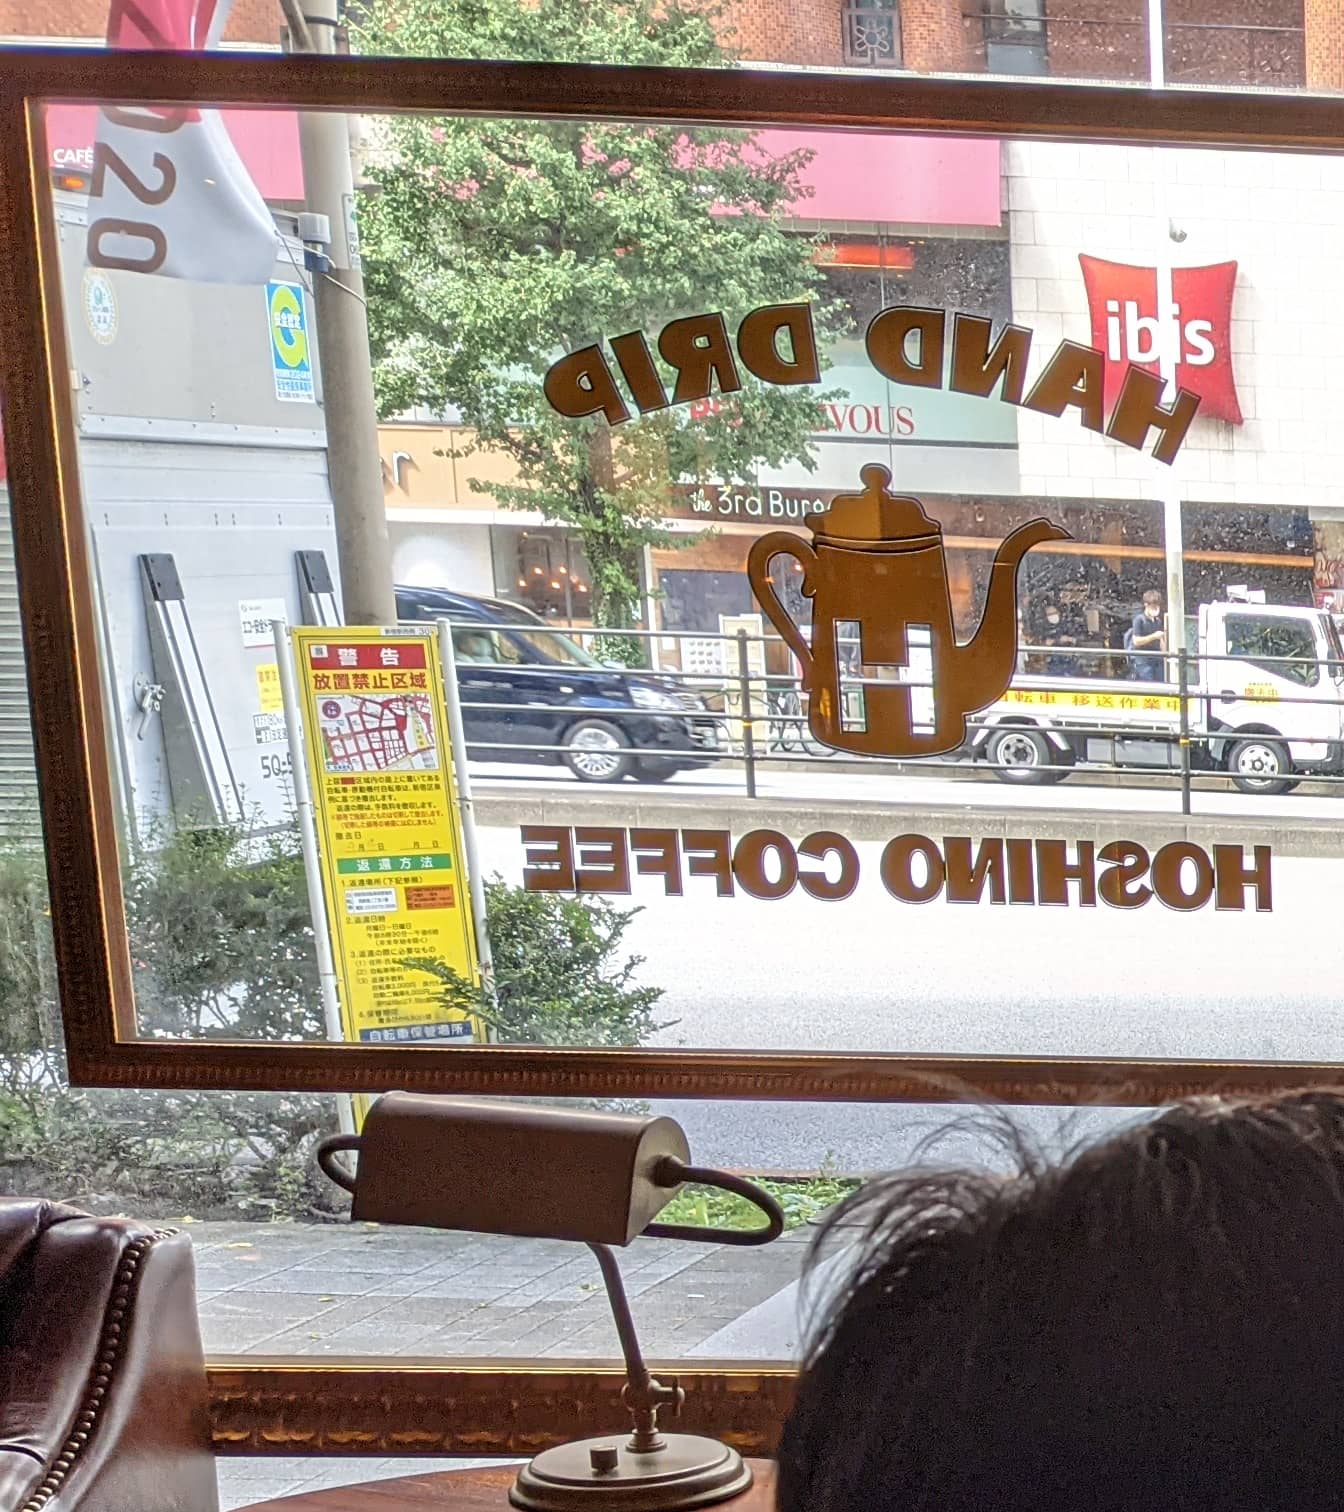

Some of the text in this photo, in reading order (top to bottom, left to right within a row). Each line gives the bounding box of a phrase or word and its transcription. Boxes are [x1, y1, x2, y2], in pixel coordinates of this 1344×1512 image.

[53, 147, 94, 164] CAFÉ
[1106, 299, 1216, 366] ibis
[337, 648, 399, 666] 警告
[313, 672, 427, 690] 放置禁止区域
